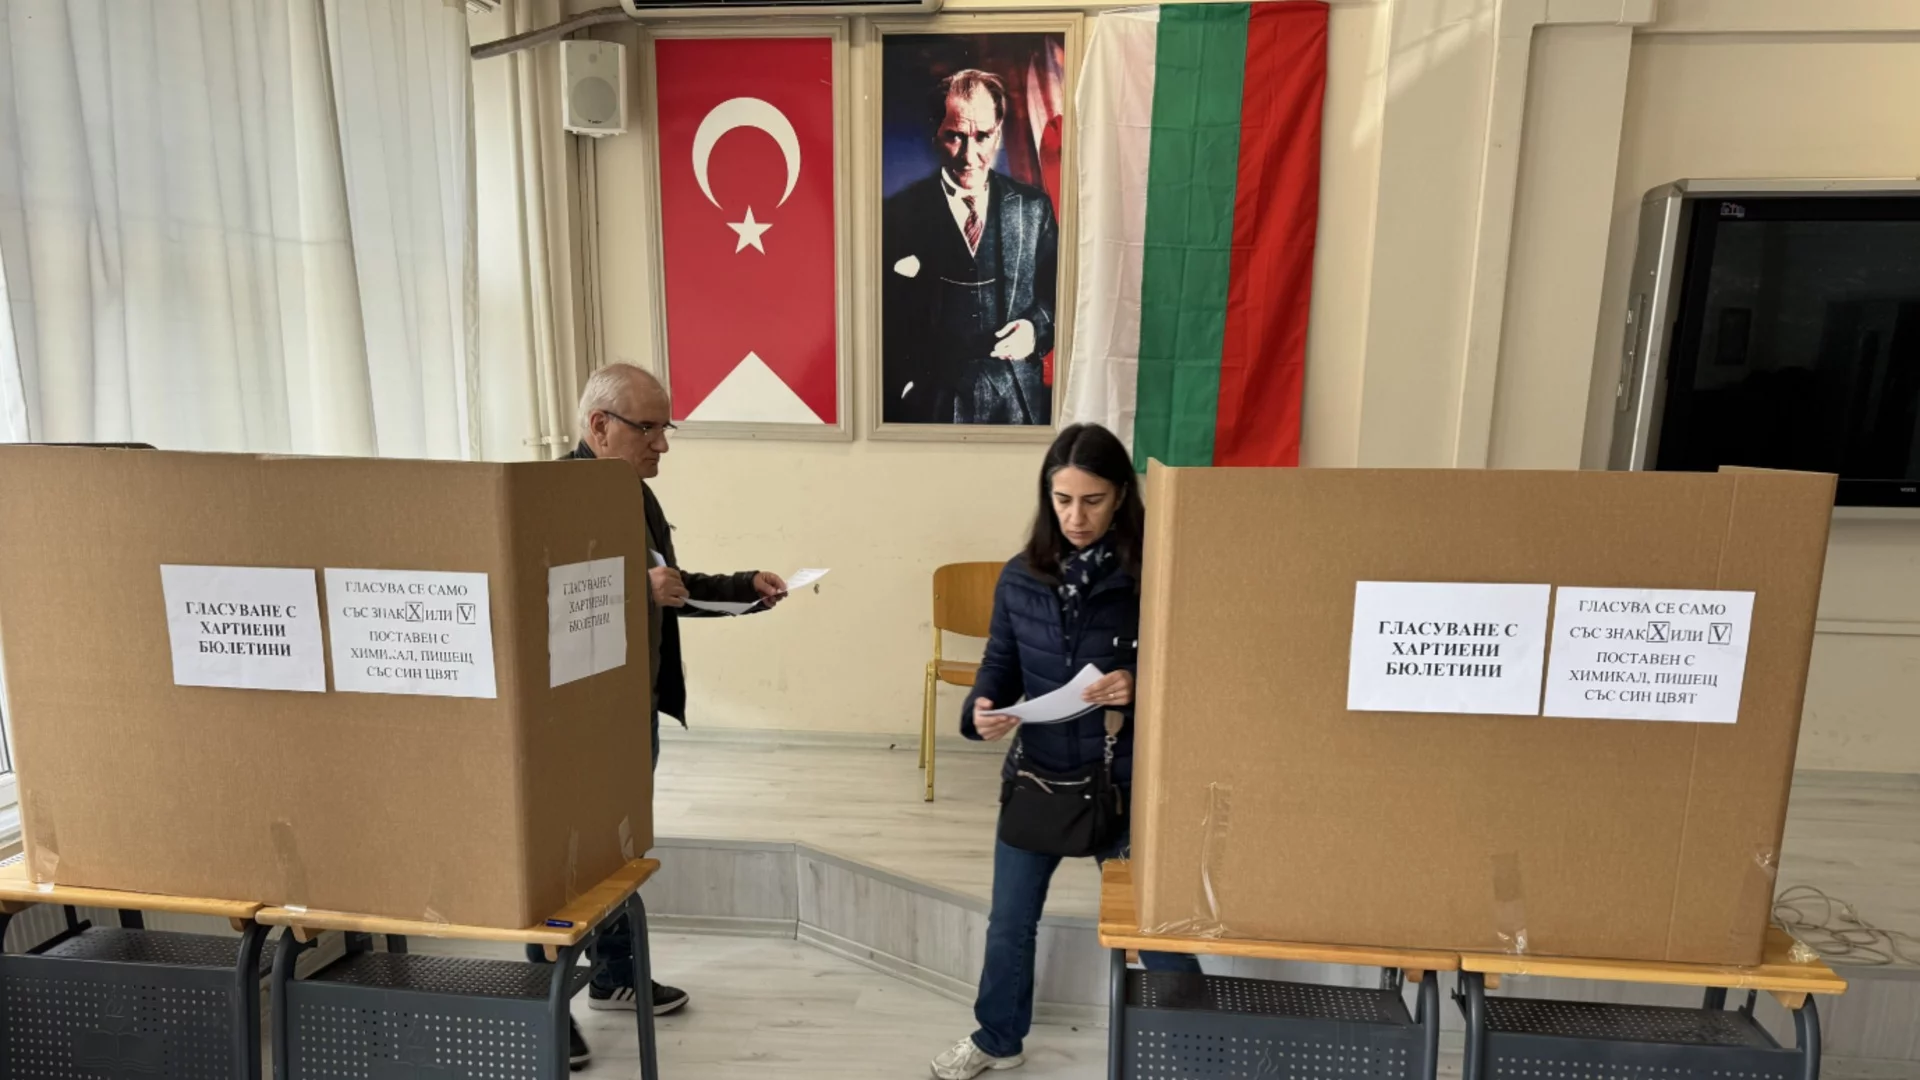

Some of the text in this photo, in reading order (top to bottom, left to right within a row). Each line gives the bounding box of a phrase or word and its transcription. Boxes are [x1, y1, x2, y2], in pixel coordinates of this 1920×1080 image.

[345, 581, 468, 596] ГЛАСУВА СЕ САМО
[186, 601, 297, 618] ГЛАСУВАНЕ С
[343, 606, 368, 618] СЪС
[371, 607, 405, 620] ЗНАК
[425, 609, 452, 621] ИЛИ
[1579, 600, 1726, 616] ГЛАСУВА СЕ САМО
[200, 621, 286, 637] ХАРТИЕНИ
[1379, 621, 1519, 637] ГЛАСУВАНЕ С
[1569, 626, 1602, 639] СЪС
[1605, 628, 1646, 641] ЗНАК
[1670, 629, 1703, 642] ИЛИ
[369, 630, 450, 645] ПОСТАВЕН С
[199, 640, 291, 657] БЮЛЕТИНИ
[1392, 641, 1501, 657] ХАРТИЕНИ
[420, 650, 474, 665] ПИШЕЩ
[1596, 651, 1696, 666] ПОСТАВЕН С
[366, 665, 459, 681] СЪС СИН ЦВЯТ
[1386, 661, 1502, 678] БЮЛЕТИНИ
[1569, 670, 1718, 687] ХИМИКАЛ, ПИШЕЩ
[1584, 689, 1698, 704] СЪС СИН ЦВЯТ
